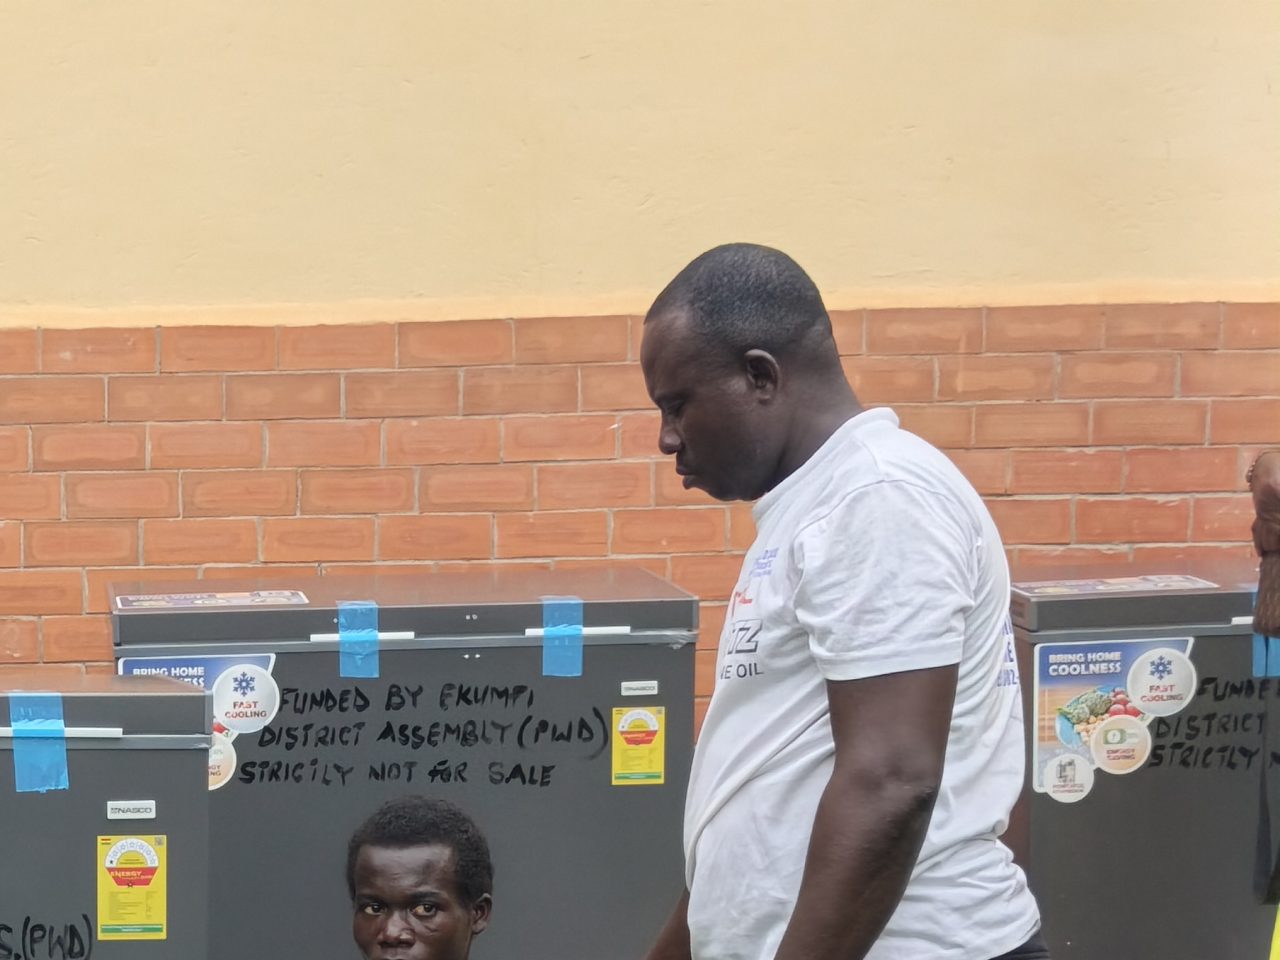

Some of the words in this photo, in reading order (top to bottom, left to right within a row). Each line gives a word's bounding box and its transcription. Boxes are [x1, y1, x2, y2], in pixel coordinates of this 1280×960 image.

[1048, 653, 1085, 664] BRING
[1087, 651, 1122, 663] HOME
[132, 667, 168, 676] BRING
[171, 666, 205, 677] HOME
[736, 662, 764, 678] OIL
[1048, 663, 1121, 676] COOLNESS
[1148, 684, 1176, 693] FAST
[279, 686, 370, 714] FUNDED
[385, 683, 423, 711] BY
[1140, 693, 1184, 702] COOLING
[232, 701, 259, 709] FAST
[225, 710, 268, 719] COOLING
[257, 721, 367, 750] DISTRICT
[1147, 742, 1261, 770] STRICTLY
[238, 758, 354, 787] STRICTLY
[369, 761, 418, 783] NOT
[488, 761, 556, 787] SALE
